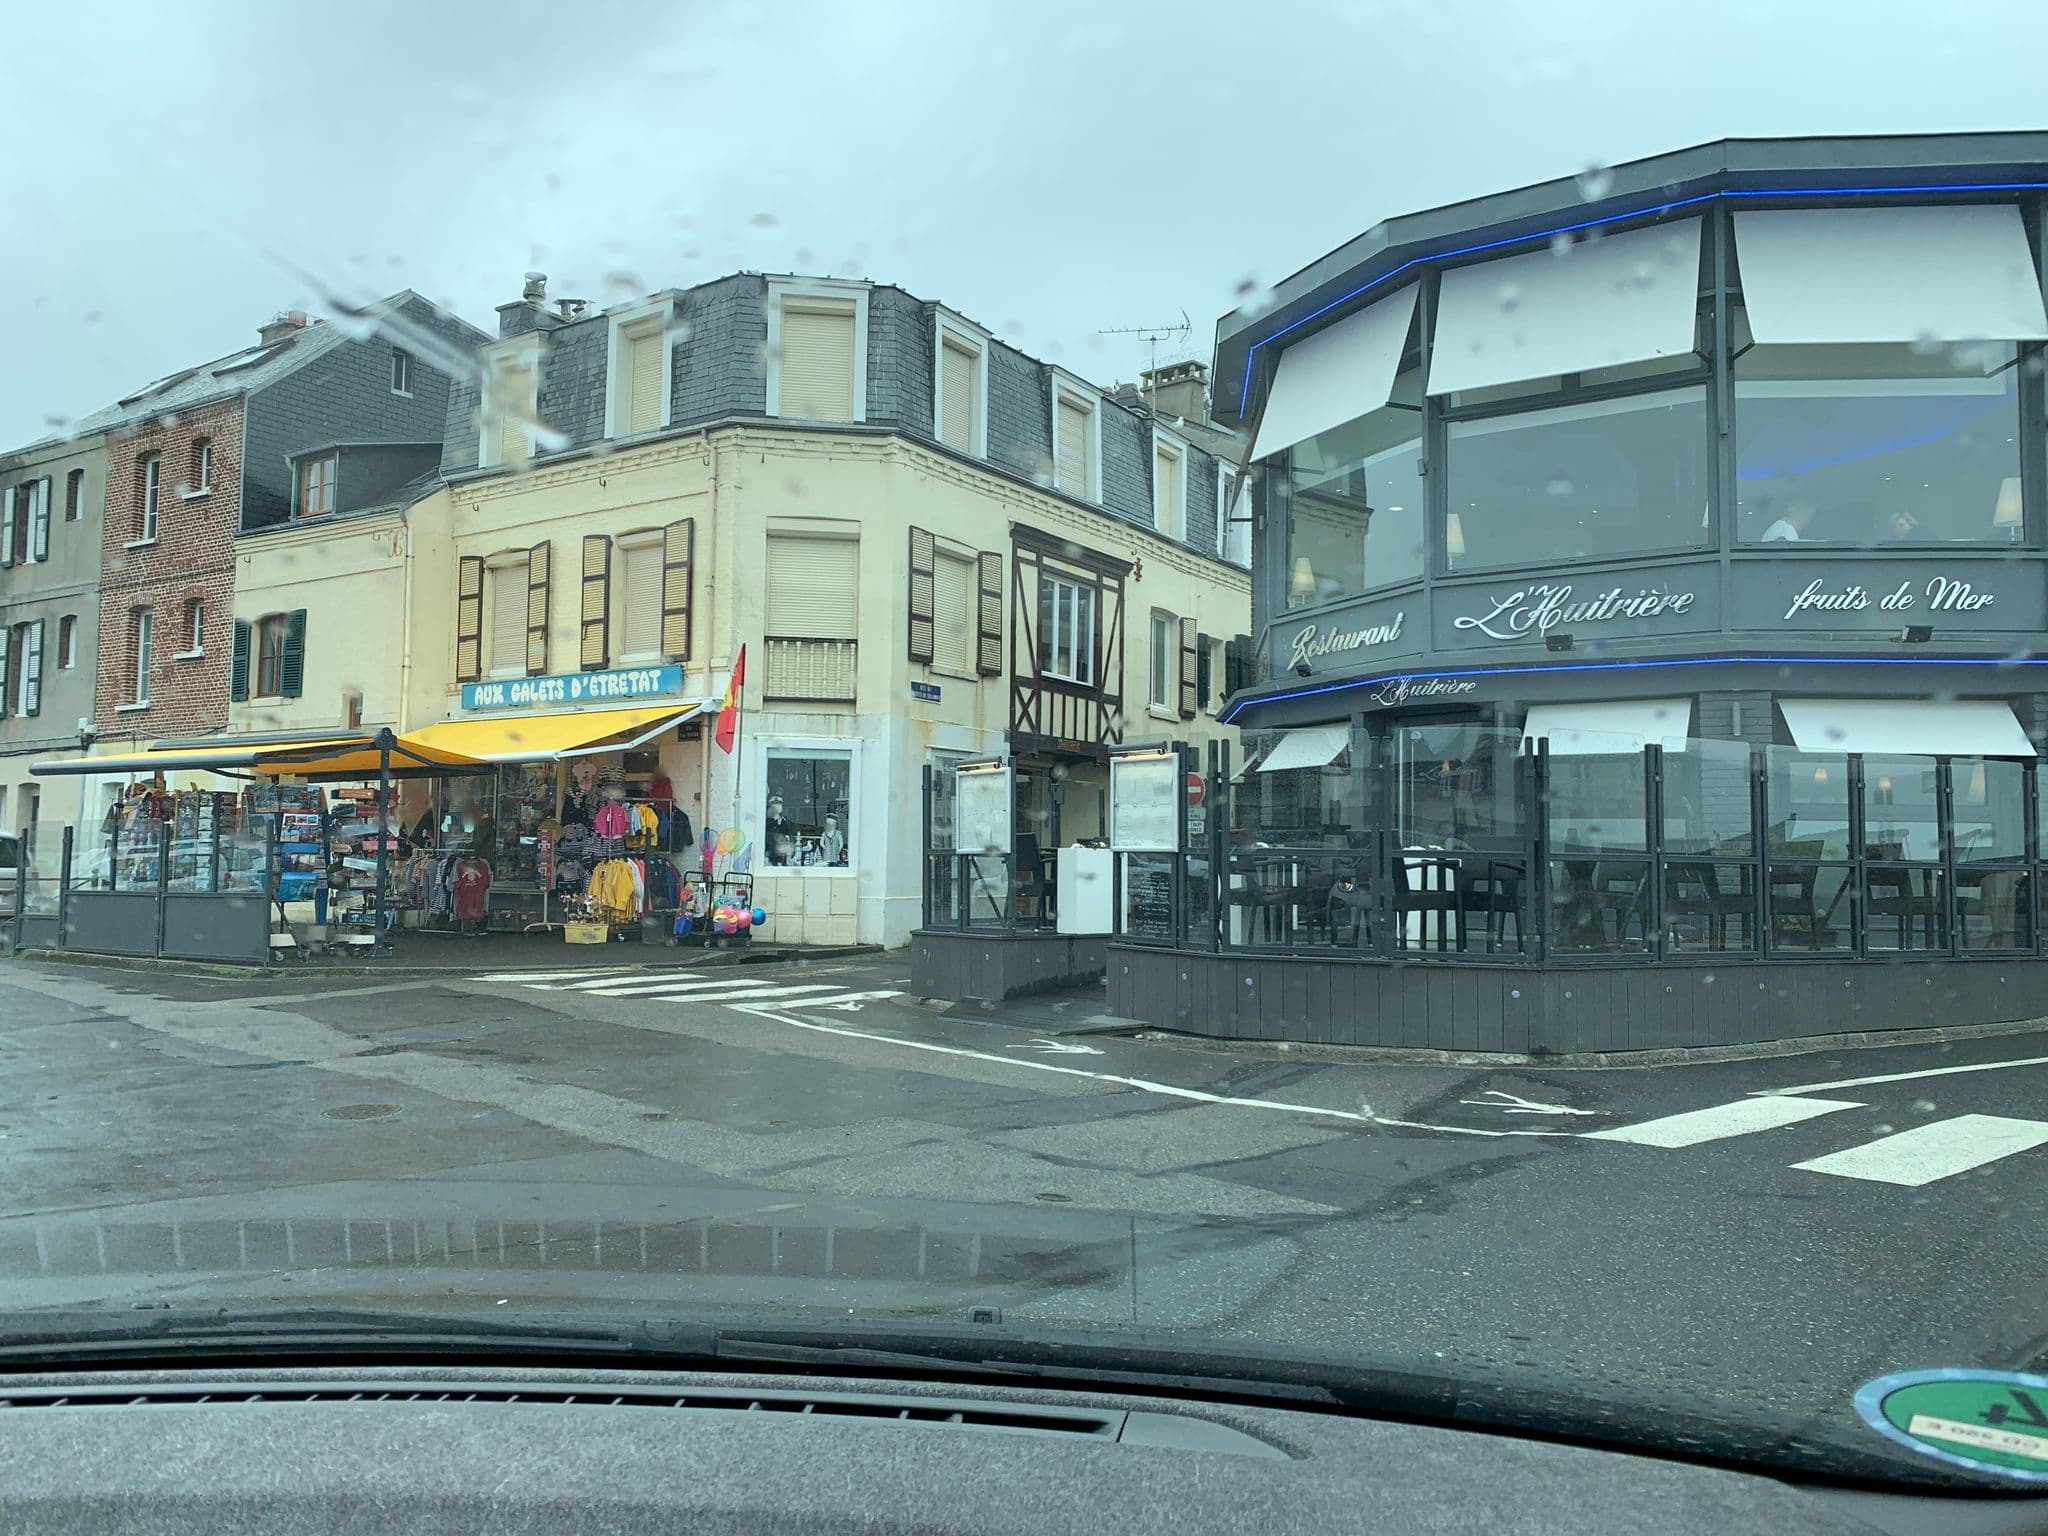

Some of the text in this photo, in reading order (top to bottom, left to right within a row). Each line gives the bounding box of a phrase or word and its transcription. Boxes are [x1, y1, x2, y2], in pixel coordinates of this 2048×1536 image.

[1453, 583, 1695, 640] L'Huitrière
[1783, 576, 1994, 620] fruits de Mer
[1286, 611, 1404, 672] Restaurant
[474, 669, 662, 705] AUX GALETS D'ETRETAT
